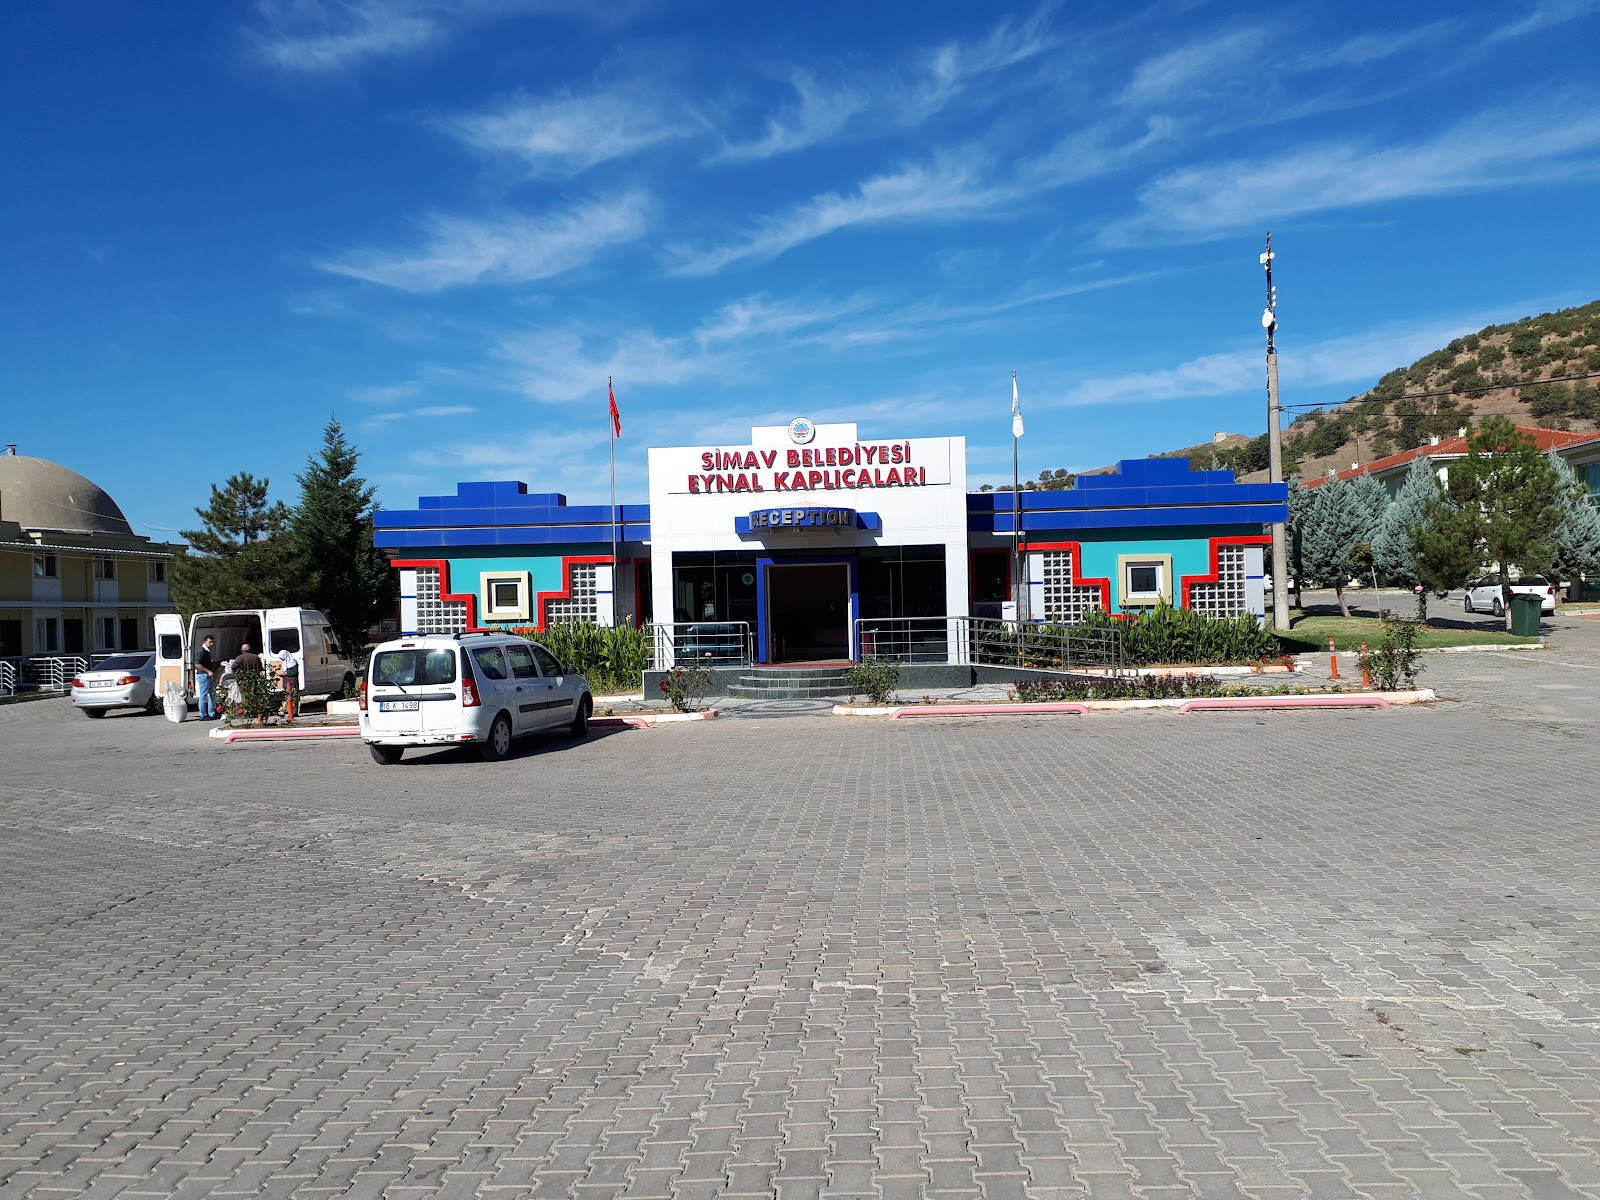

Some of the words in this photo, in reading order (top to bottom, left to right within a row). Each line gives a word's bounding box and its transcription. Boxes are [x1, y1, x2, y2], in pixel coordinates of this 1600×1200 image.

[701, 448, 777, 471] SİMAV
[786, 441, 911, 468] BELEDİYESİ
[688, 472, 764, 494] EYNAL
[774, 466, 926, 492] KAPLICALARI
[752, 510, 849, 528] RECEPTION
[392, 702, 398, 710] K
[401, 701, 418, 709] 1498
